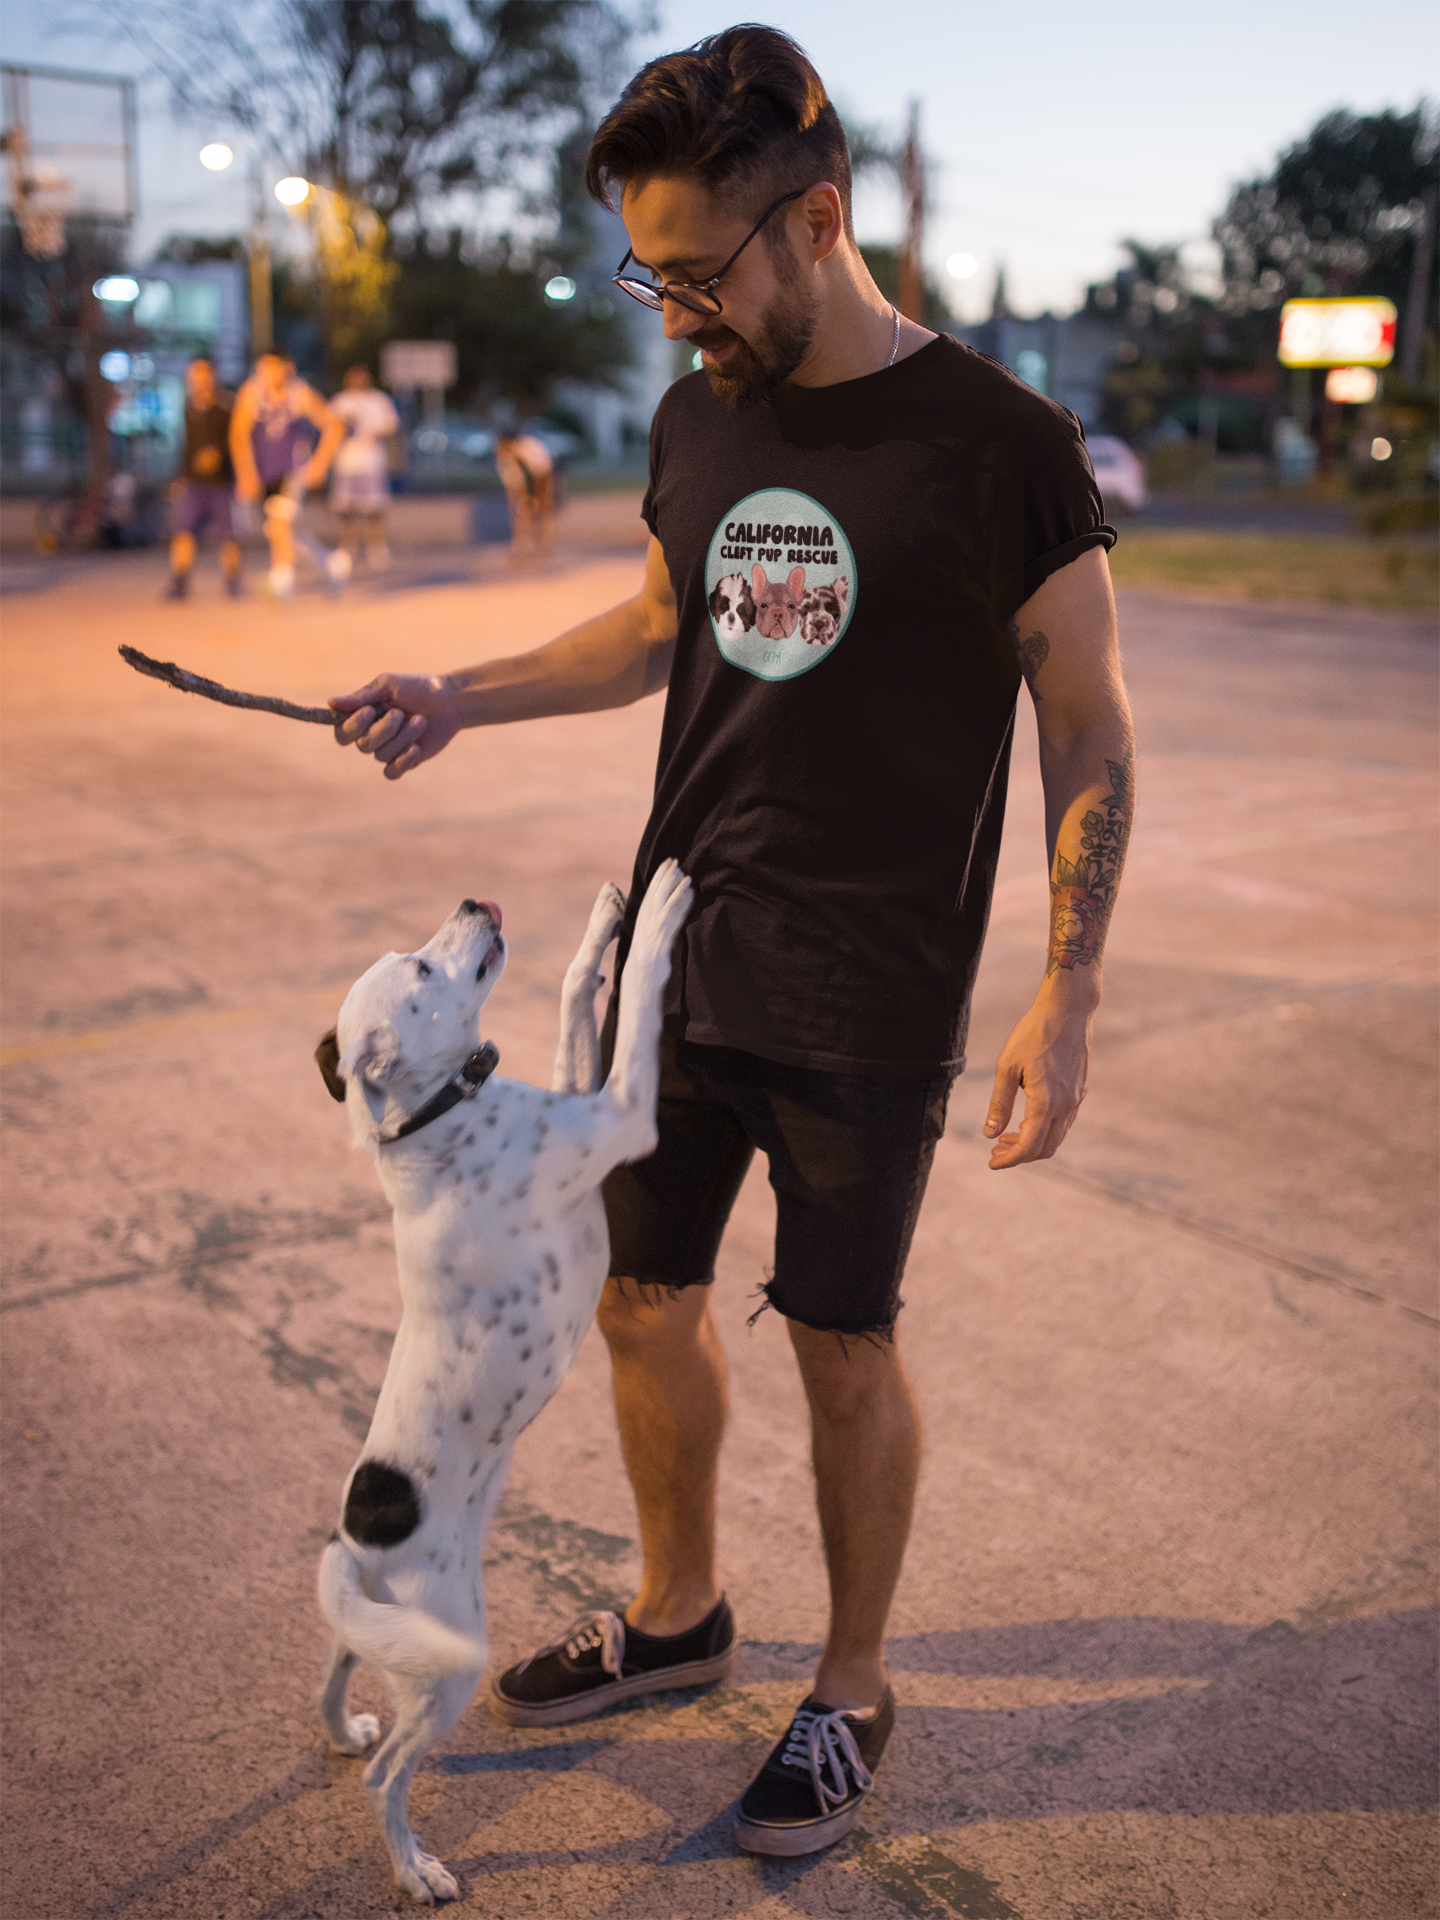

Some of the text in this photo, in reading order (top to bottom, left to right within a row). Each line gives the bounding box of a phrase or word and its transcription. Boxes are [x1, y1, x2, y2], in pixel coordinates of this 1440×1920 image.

[725, 522, 834, 547] CALIFORNIA
[720, 545, 838, 565] CLEFT PUP RESCUE
